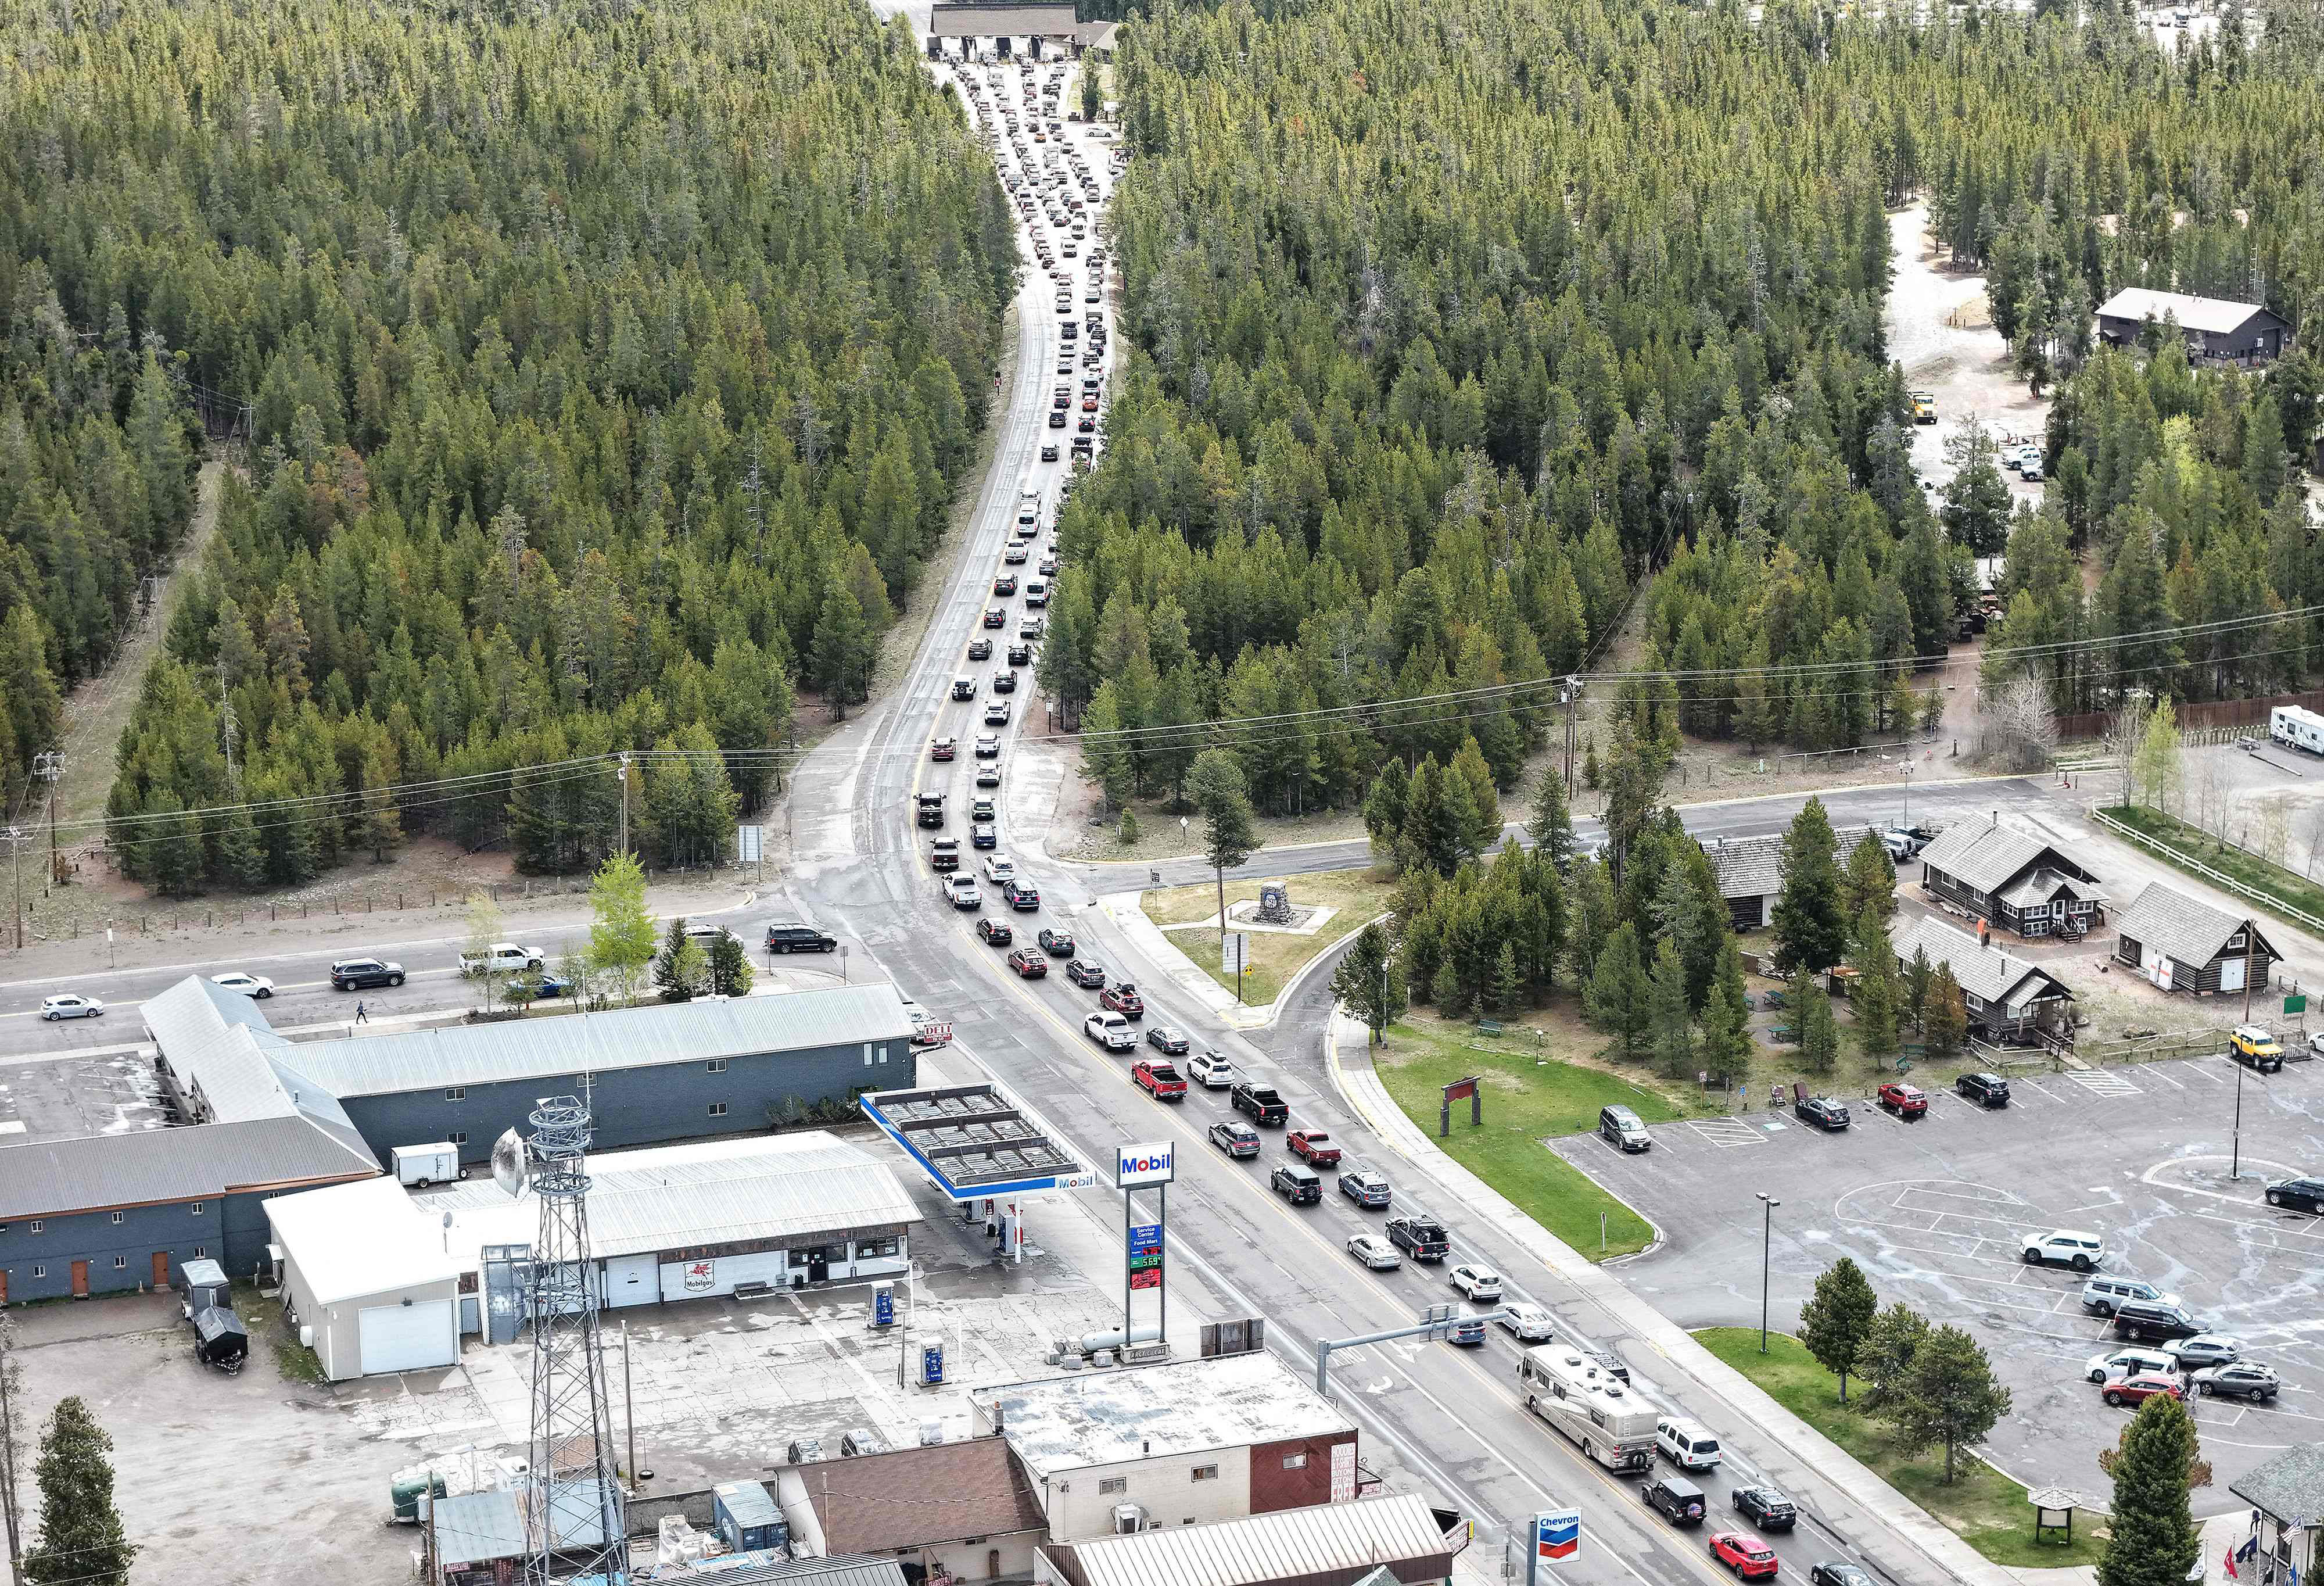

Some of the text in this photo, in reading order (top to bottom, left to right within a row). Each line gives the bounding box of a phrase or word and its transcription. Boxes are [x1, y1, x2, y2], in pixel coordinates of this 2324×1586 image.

[926, 1025, 951, 1034] DELI
[1122, 1154, 1170, 1173] Mobil
[1059, 1176, 1093, 1189] Mobil
[1331, 1445, 1355, 1457] HOODIES
[1336, 1457, 1355, 1469] T-SHIRTS
[1332, 1467, 1355, 1477] BUY ONE
[1343, 1475, 1355, 1483] ONE
[1331, 1483, 1355, 1502] FREE
[1540, 1516, 1579, 1527] Chevron
